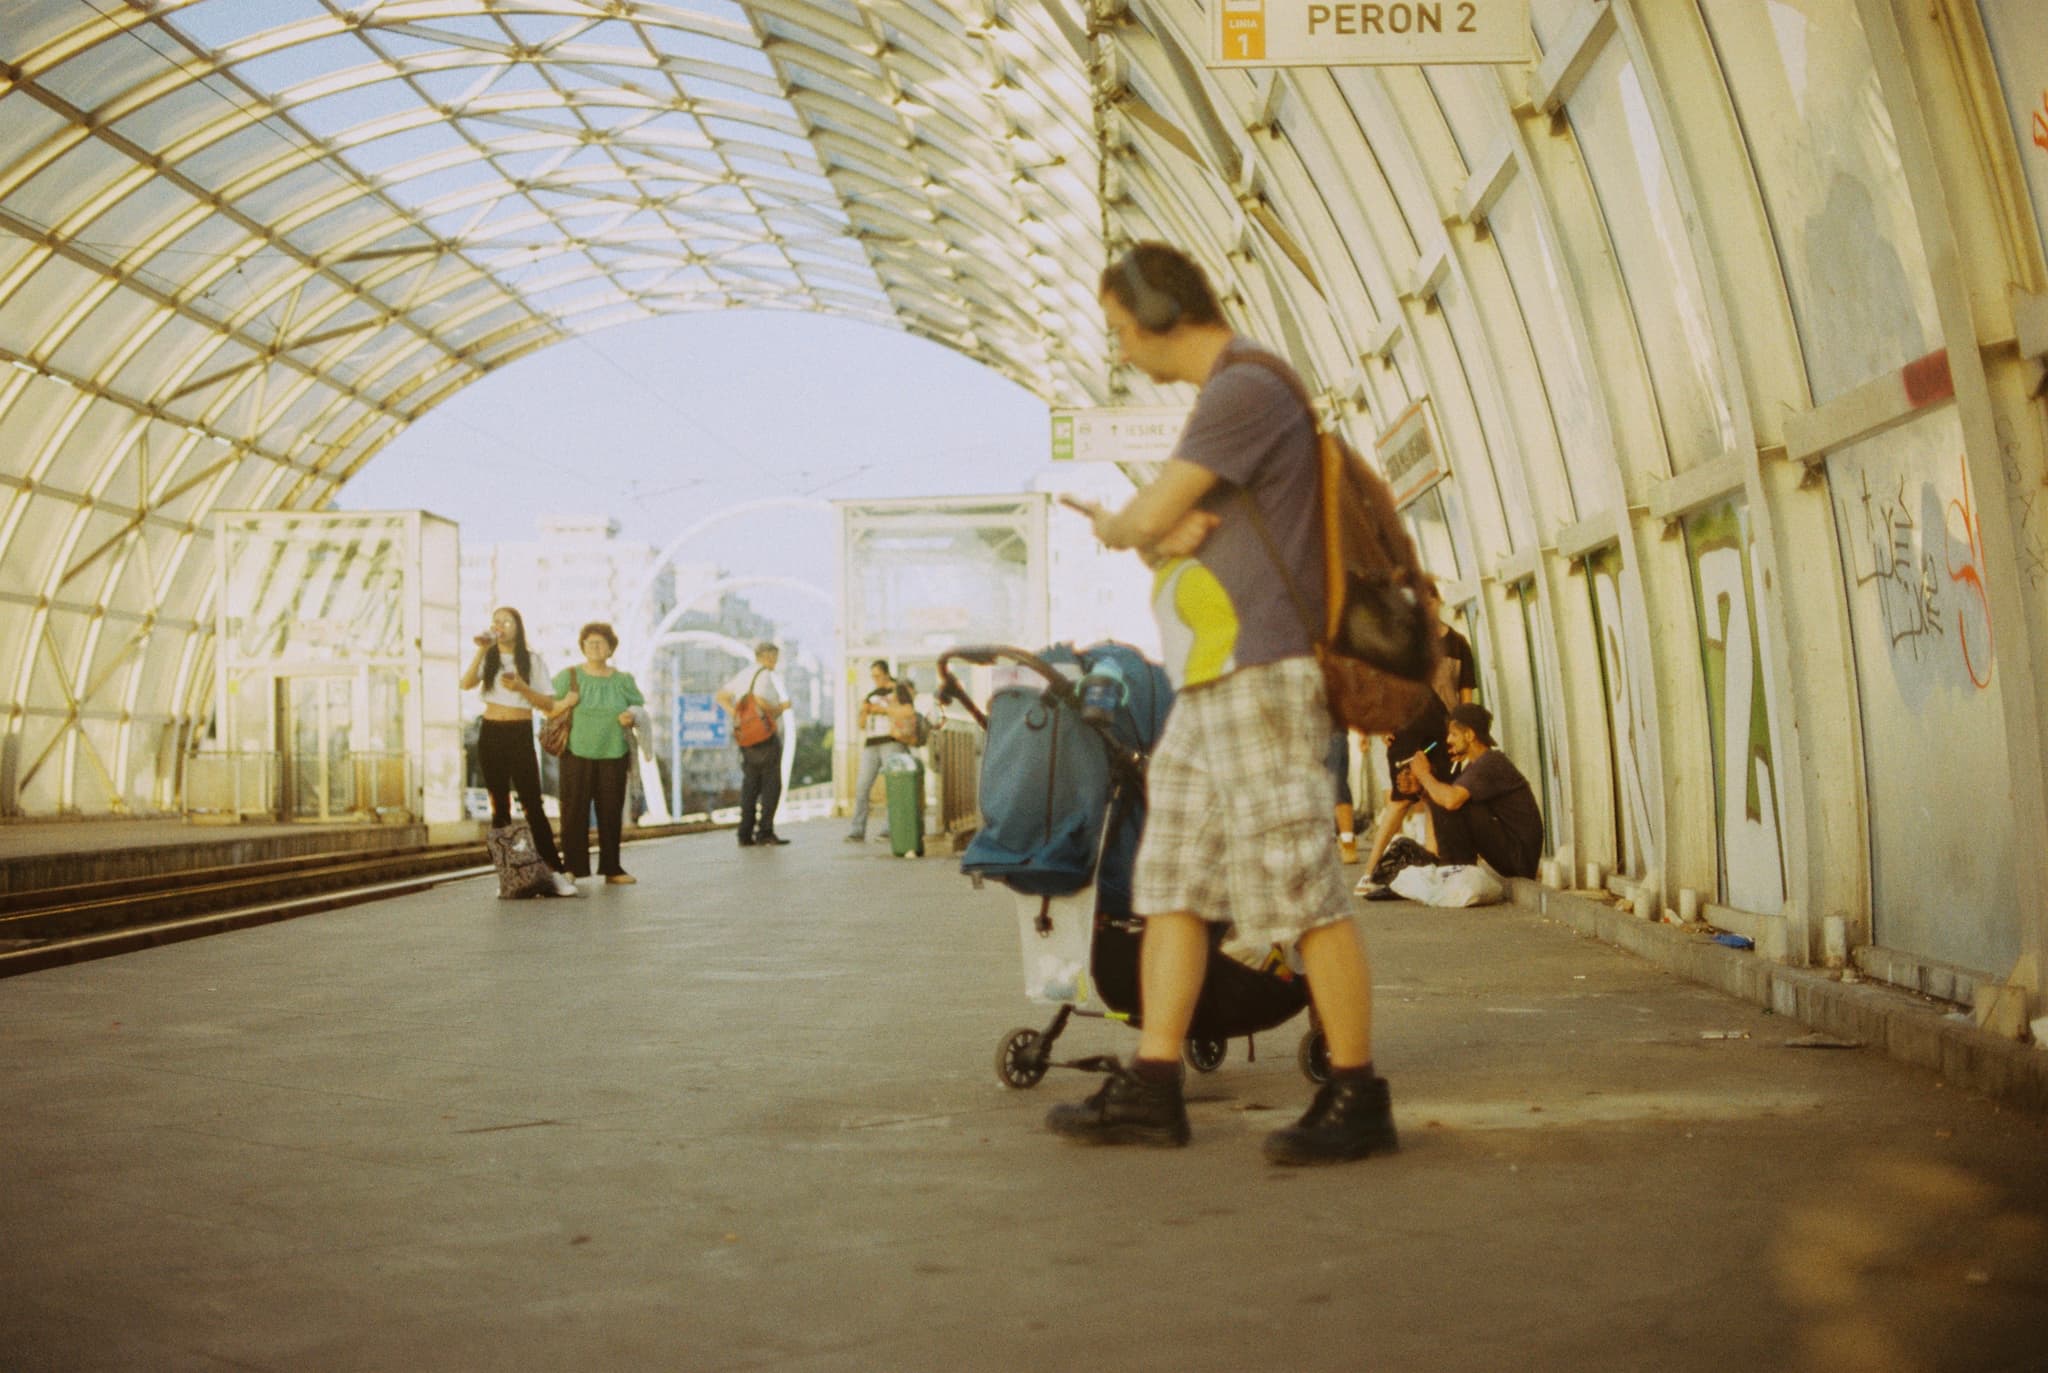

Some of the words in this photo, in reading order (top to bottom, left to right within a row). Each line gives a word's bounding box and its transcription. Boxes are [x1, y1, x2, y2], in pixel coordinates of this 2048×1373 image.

[1229, 18, 1258, 29] LINIA
[1307, 1, 1443, 35] PERON
[1456, 1, 1478, 33] 2
[1237, 32, 1249, 57] 1
